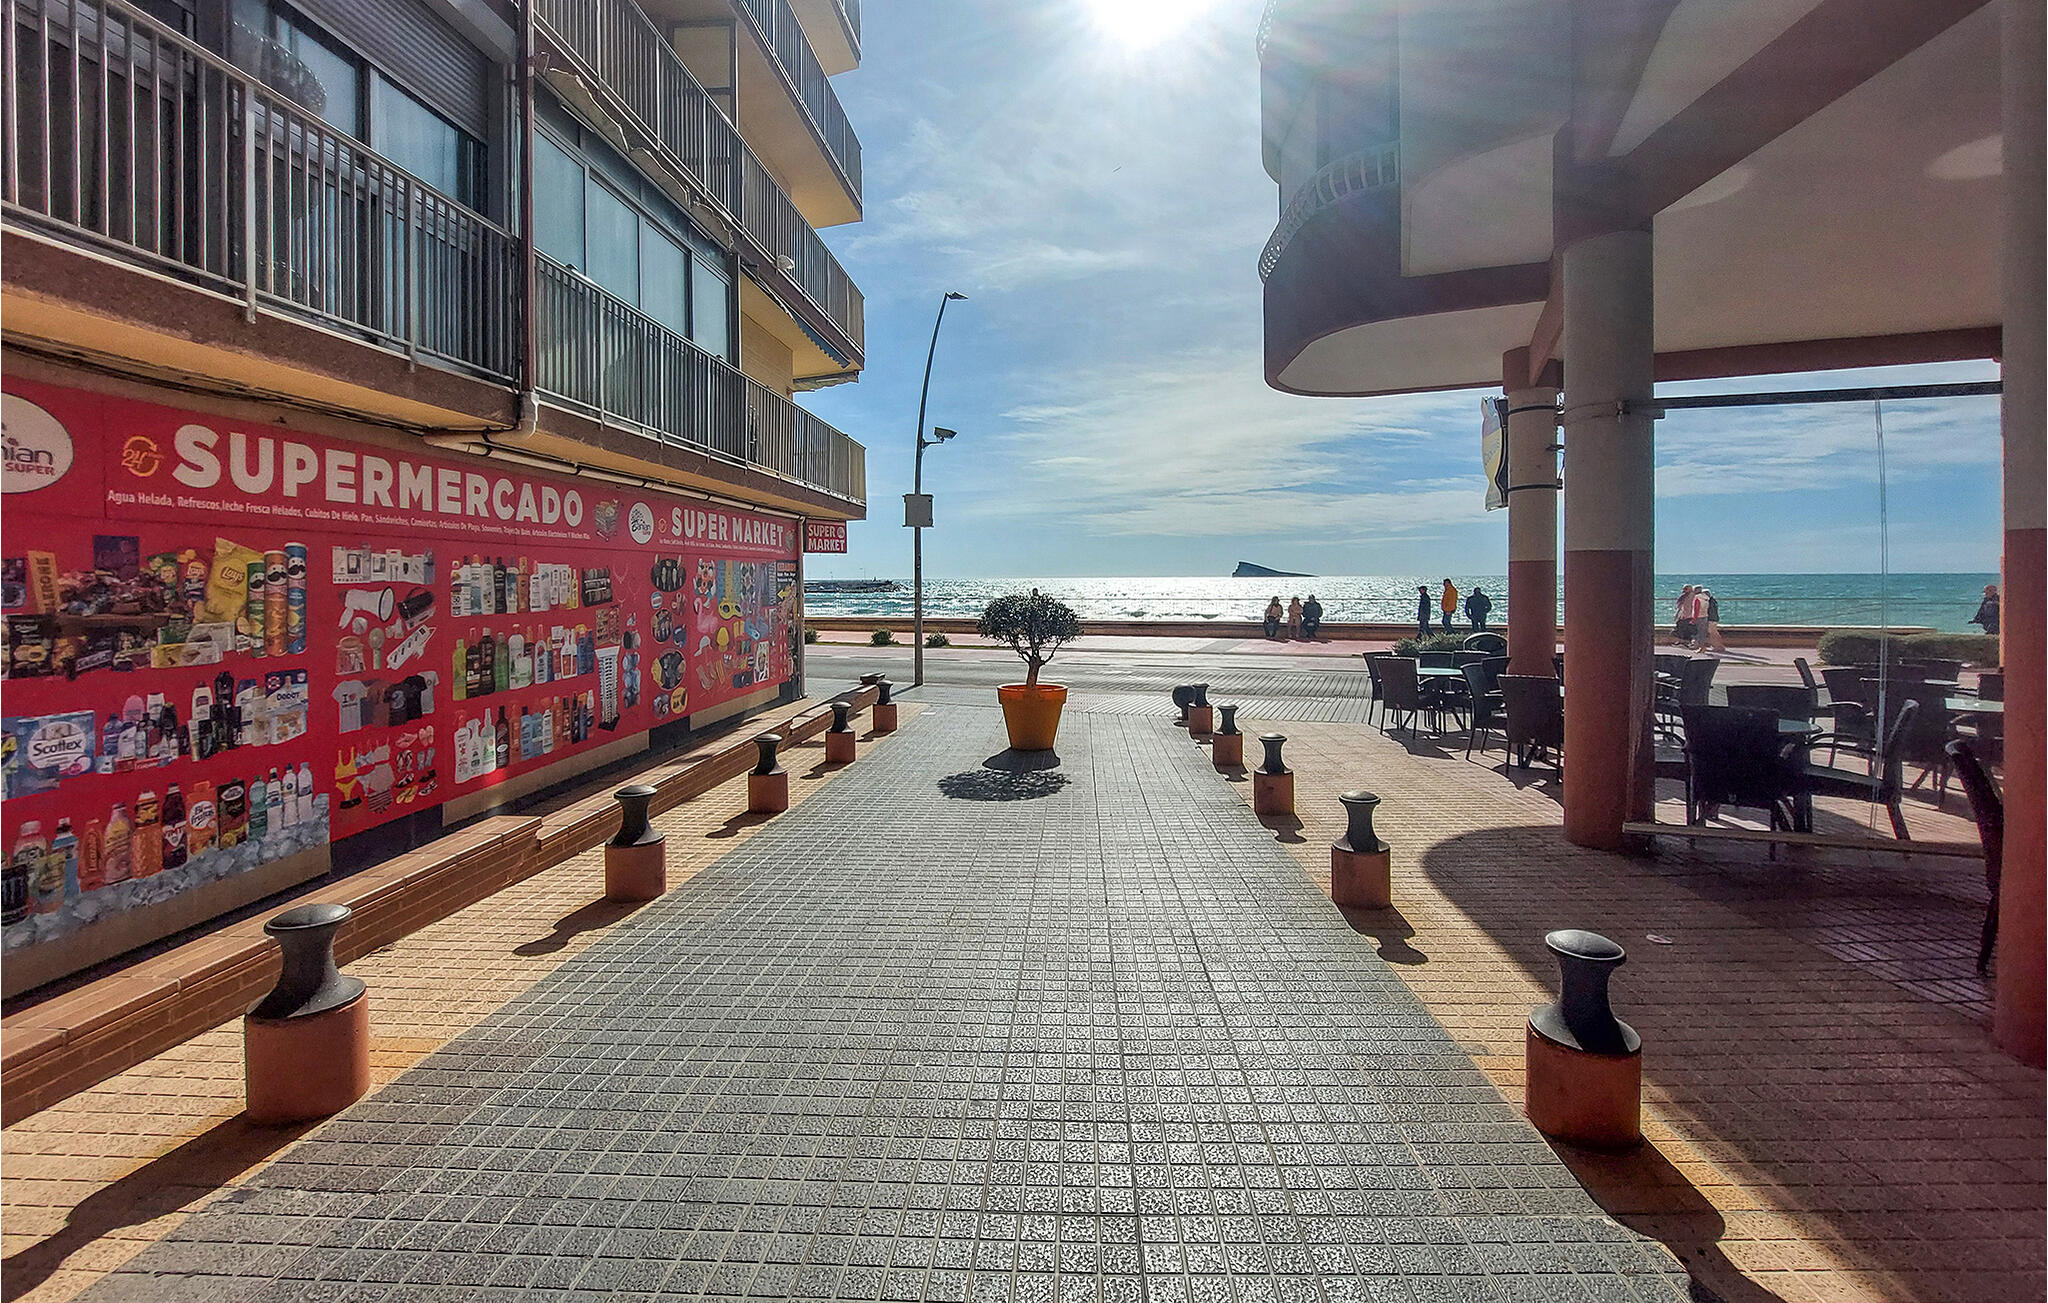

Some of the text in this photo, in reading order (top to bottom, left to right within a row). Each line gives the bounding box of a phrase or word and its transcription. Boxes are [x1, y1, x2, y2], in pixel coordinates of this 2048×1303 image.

[5, 462, 56, 476] SUPER
[171, 424, 583, 528] SUPERMERCADO
[108, 490, 135, 505] Agua
[138, 492, 175, 508] Helada,
[246, 502, 271, 514] Fresca
[672, 506, 728, 541] SUPER
[732, 517, 783, 547] MARKET
[808, 525, 835, 538] SUPER
[808, 538, 845, 552] MARKET
[33, 739, 82, 757] Scottex
